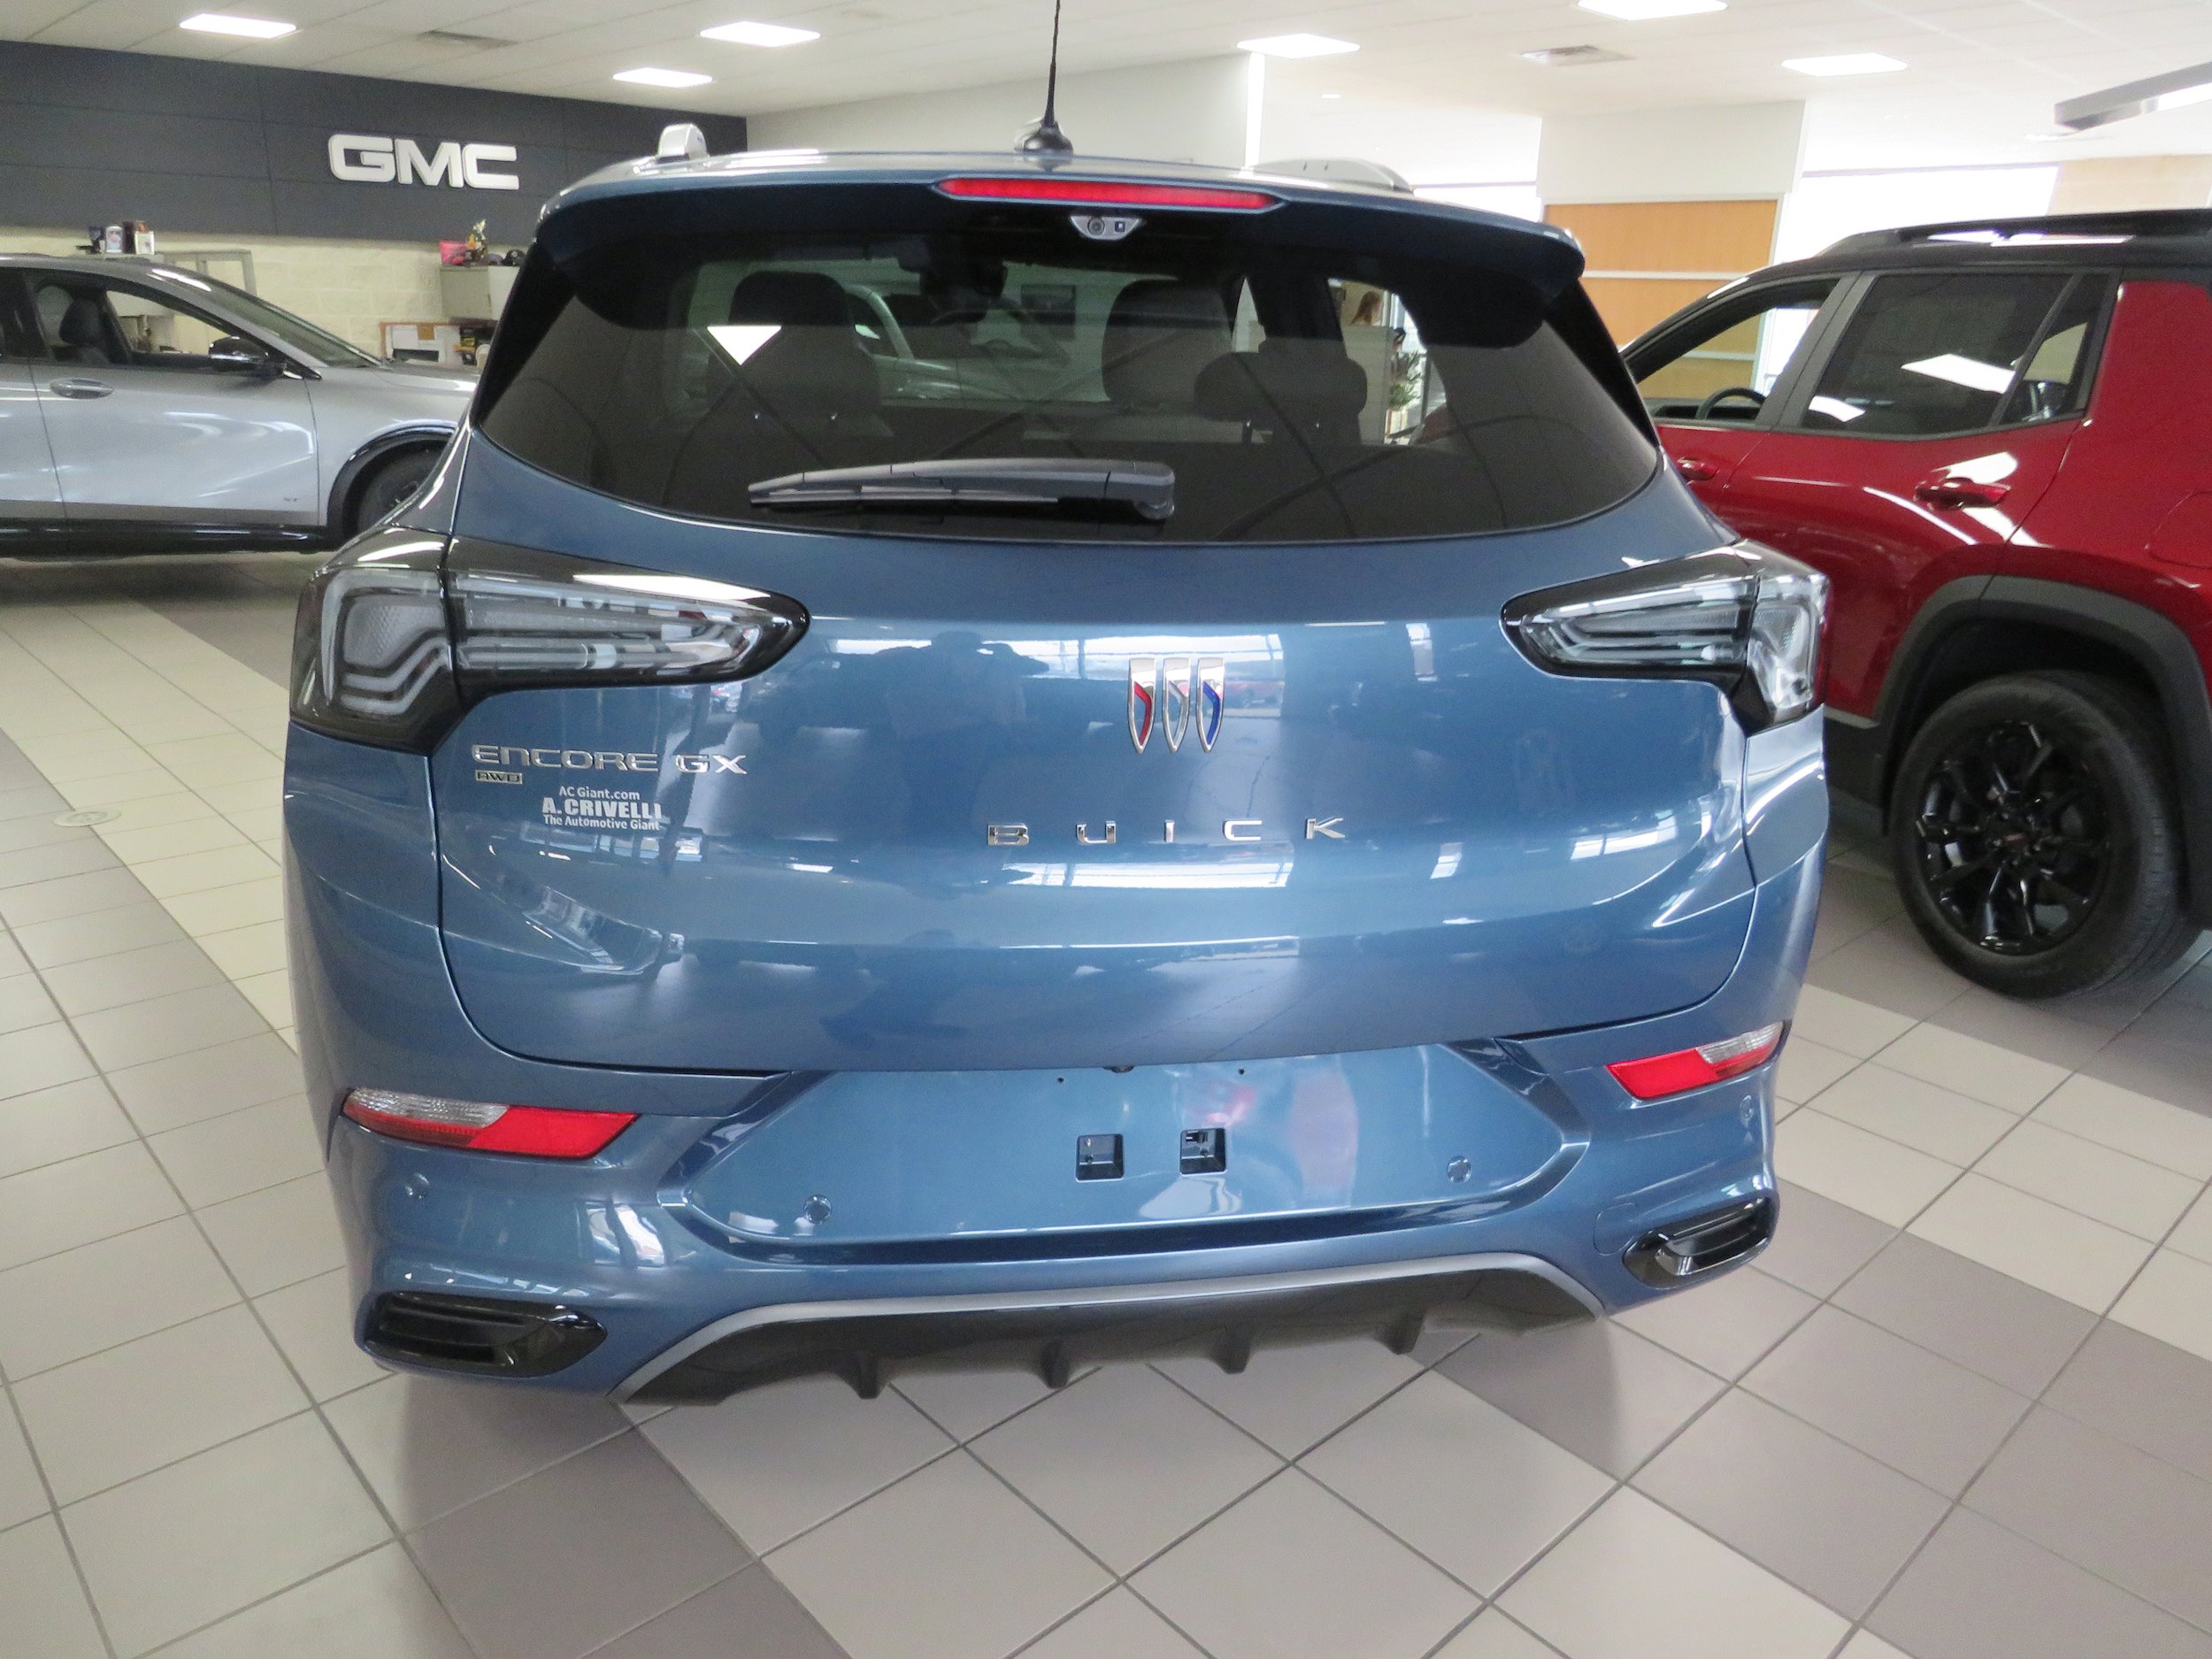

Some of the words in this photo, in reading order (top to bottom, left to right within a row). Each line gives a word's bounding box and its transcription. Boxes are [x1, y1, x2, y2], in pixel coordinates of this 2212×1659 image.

[328, 134, 520, 190] GMC
[472, 744, 659, 772] ENCORE
[675, 754, 748, 775] GX
[476, 771, 522, 784] AWD
[542, 797, 562, 814] A.
[564, 798, 662, 819] CRIVELLI
[542, 814, 563, 826] The
[565, 815, 627, 829] Automotive
[630, 818, 660, 831] Giant
[987, 817, 1346, 846] BUICK
